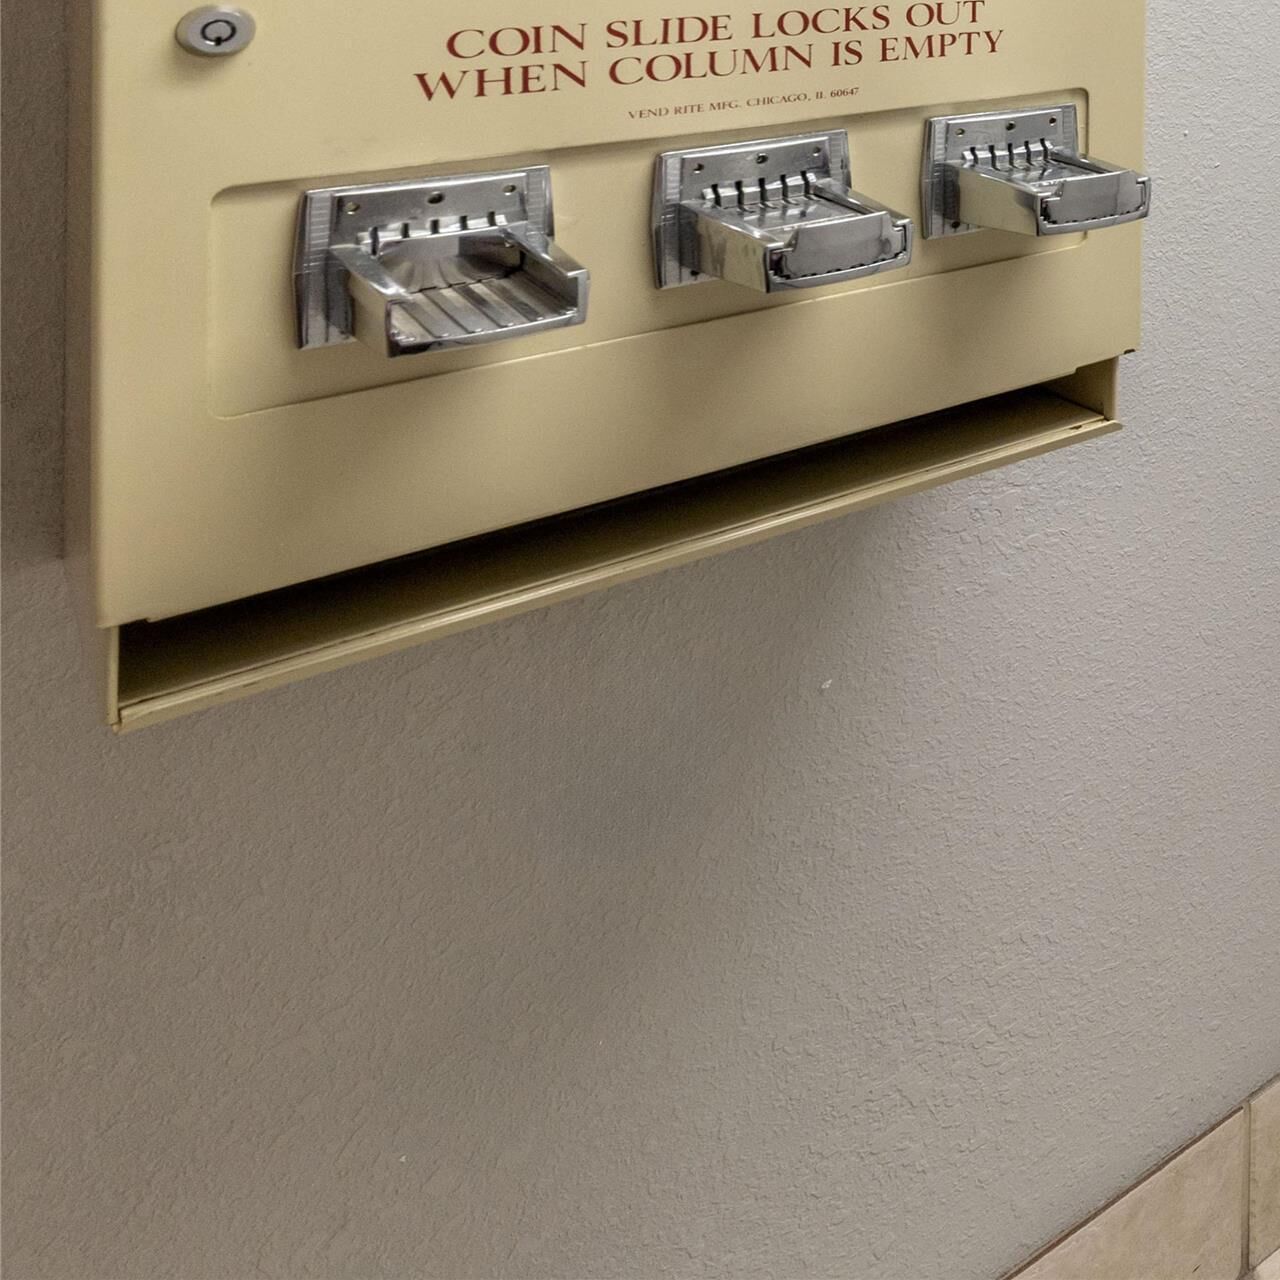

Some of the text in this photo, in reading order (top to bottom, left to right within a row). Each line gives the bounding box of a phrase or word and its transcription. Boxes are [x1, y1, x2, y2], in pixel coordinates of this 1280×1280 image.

[446, 0, 985, 59] COIN SLIDE LOCKS OUT
[413, 29, 1004, 102] WHEN COLUMN IS EMPTY
[628, 106, 669, 119] VEND
[674, 103, 704, 115] RITE
[709, 99, 739, 111] MFG.
[746, 93, 811, 108] CHICAGO,
[830, 87, 859, 98] 60647
